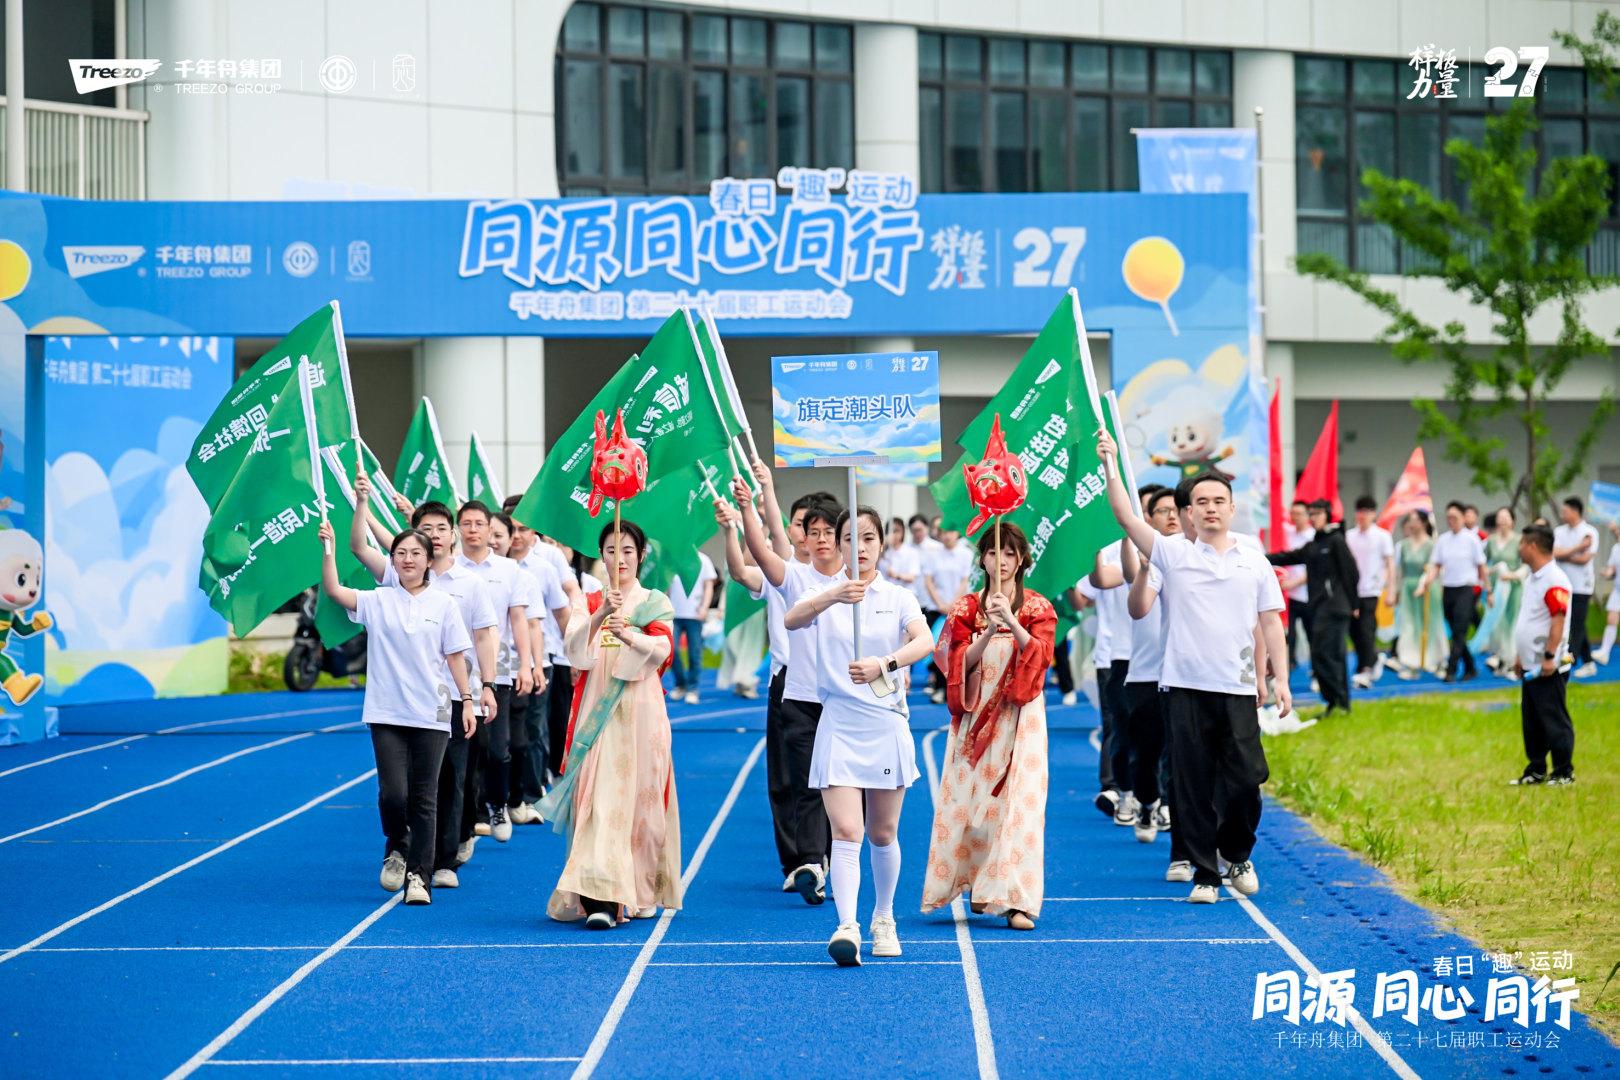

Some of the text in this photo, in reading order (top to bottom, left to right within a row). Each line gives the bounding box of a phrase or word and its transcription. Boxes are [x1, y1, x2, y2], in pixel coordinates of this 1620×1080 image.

[72, 252, 129, 264] Treezo
[155, 245, 252, 264] 千年舟集团
[1013, 227, 1086, 287] 27
[156, 267, 251, 278] TREEZO GROUP
[512, 291, 622, 318] 千年舟集团
[45, 359, 89, 385] 年舟集团
[911, 356, 929, 371] 27
[797, 394, 917, 422] 旗定潮头队
